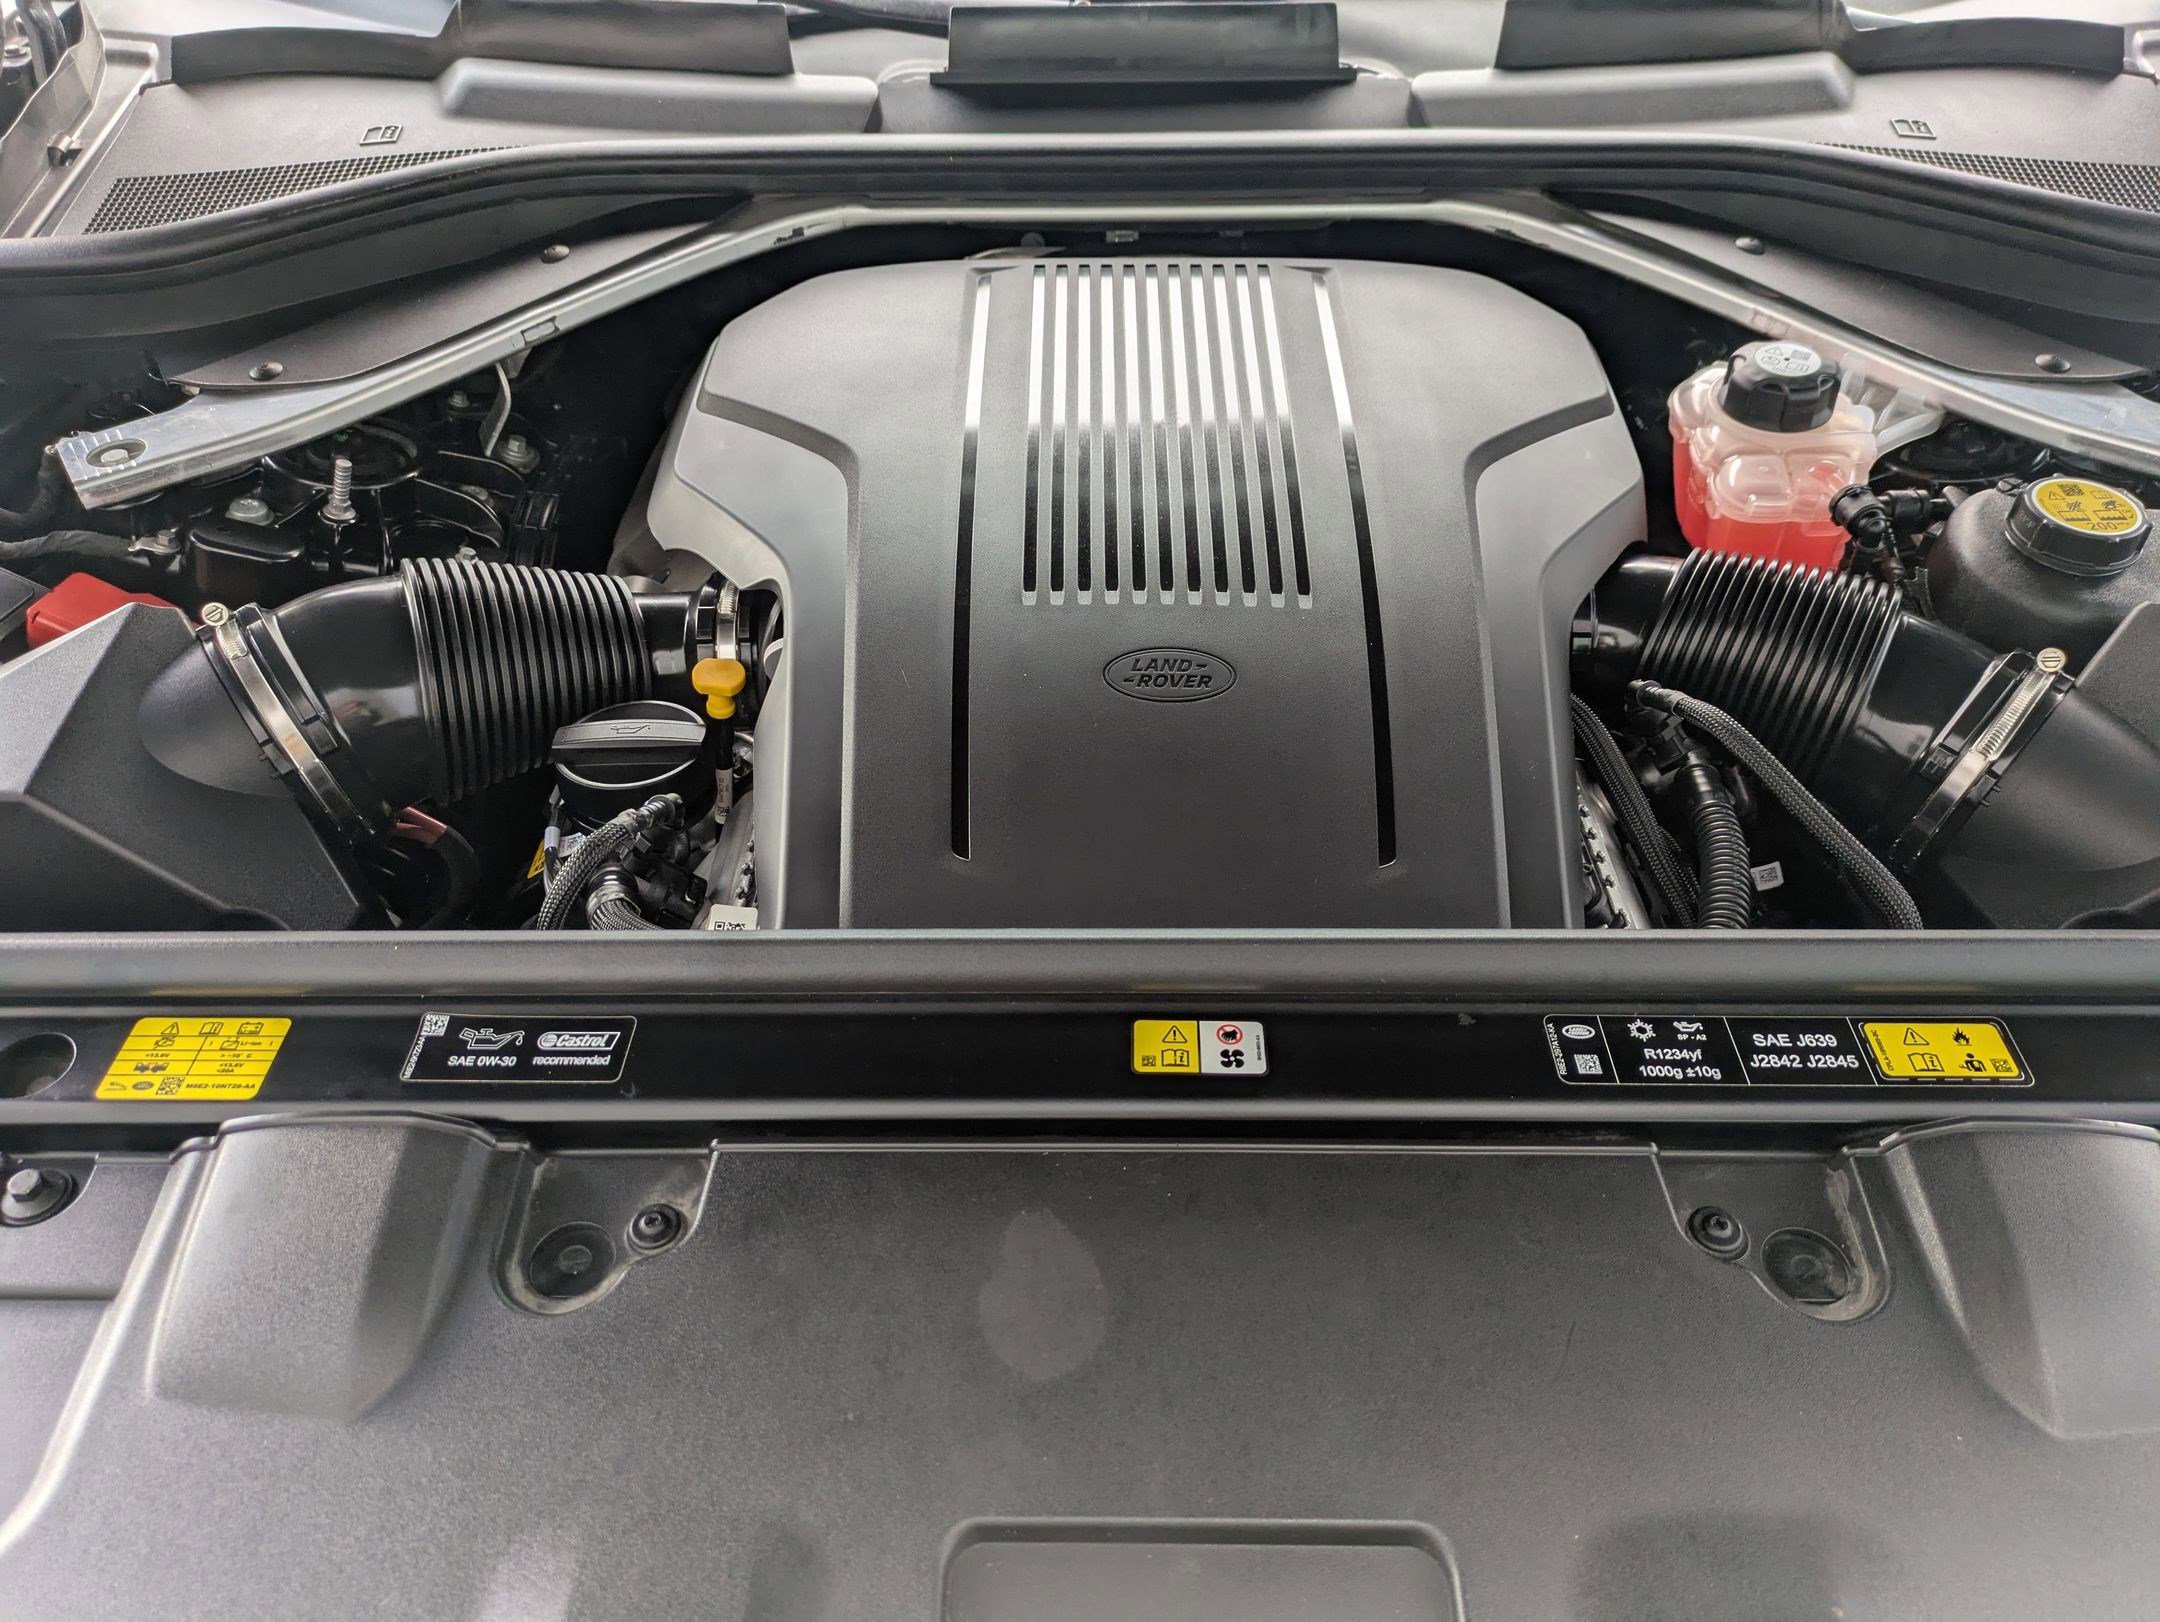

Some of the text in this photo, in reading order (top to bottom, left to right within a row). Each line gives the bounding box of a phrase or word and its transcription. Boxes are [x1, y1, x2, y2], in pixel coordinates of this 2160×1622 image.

[2088, 522, 2118, 531] 200
[556, 1034, 609, 1047] Castrol
[1752, 1033, 1838, 1047] SAE J639
[447, 1055, 517, 1067] SAE 0W-30
[532, 1055, 611, 1066] recommended
[1643, 1048, 1702, 1063] R1234yf
[1750, 1054, 1859, 1068] J2842 J2845
[1639, 1065, 1722, 1080] 1000g ±10g
